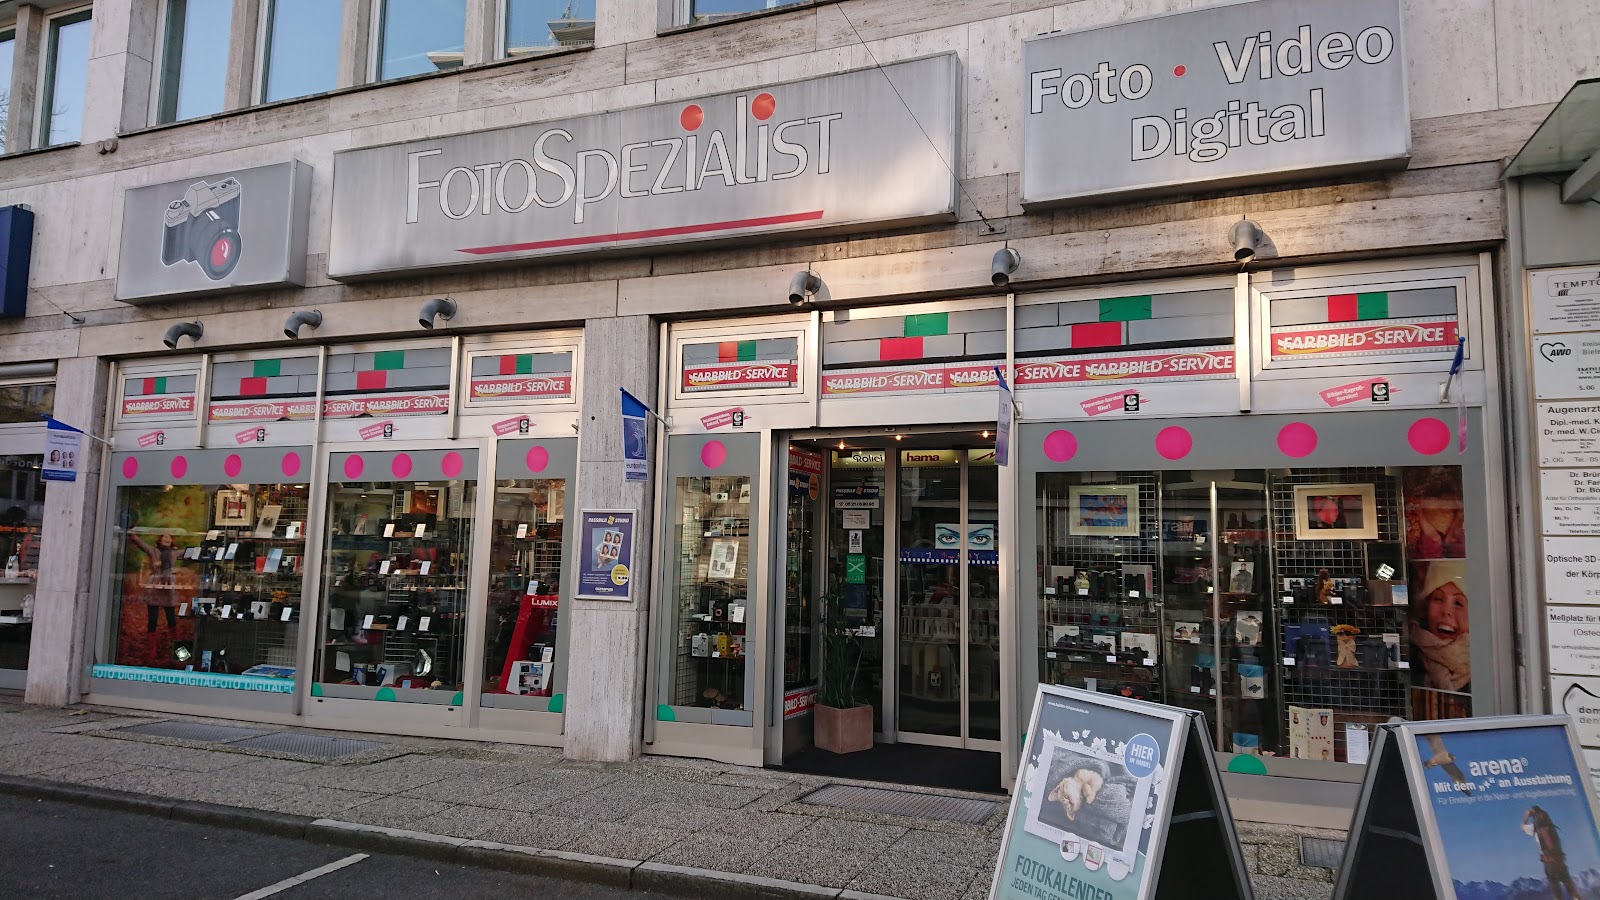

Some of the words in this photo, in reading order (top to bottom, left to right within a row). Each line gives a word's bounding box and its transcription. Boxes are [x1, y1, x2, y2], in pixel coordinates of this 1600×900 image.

[1031, 62, 1153, 115] Foto
[1213, 25, 1394, 84] Video
[1131, 88, 1325, 162] Digital
[1278, 327, 1443, 351] FARBBILD-SERVICE
[1086, 355, 1232, 378] FARBBILD-SERVICE
[689, 366, 787, 384] FARBBILD-SERVICE
[827, 372, 942, 392] FARBBILD-SERVICE
[476, 380, 564, 396] FARBBILD-SERVICE
[126, 400, 190, 412] FARBBILD-SERVICE
[213, 404, 284, 418] FARBBILD-SERVICE
[366, 397, 449, 411] FARBBILD-SERVICE
[1548, 406, 1600, 414] Augenarzt
[906, 452, 940, 461] hama
[1547, 554, 1583, 563] Optische
[1566, 570, 1579, 578] der
[531, 598, 558, 606] LUMIX
[1550, 614, 1583, 622] Meßplatz
[92, 668, 115, 679] FOTO
[1131, 743, 1154, 761] HIER
[1434, 781, 1452, 793] Mit
[1454, 780, 1476, 791] dem
[1499, 778, 1512, 788] an
[1514, 774, 1573, 787] Ausstattung
[1011, 877, 1034, 896] JEDEN
